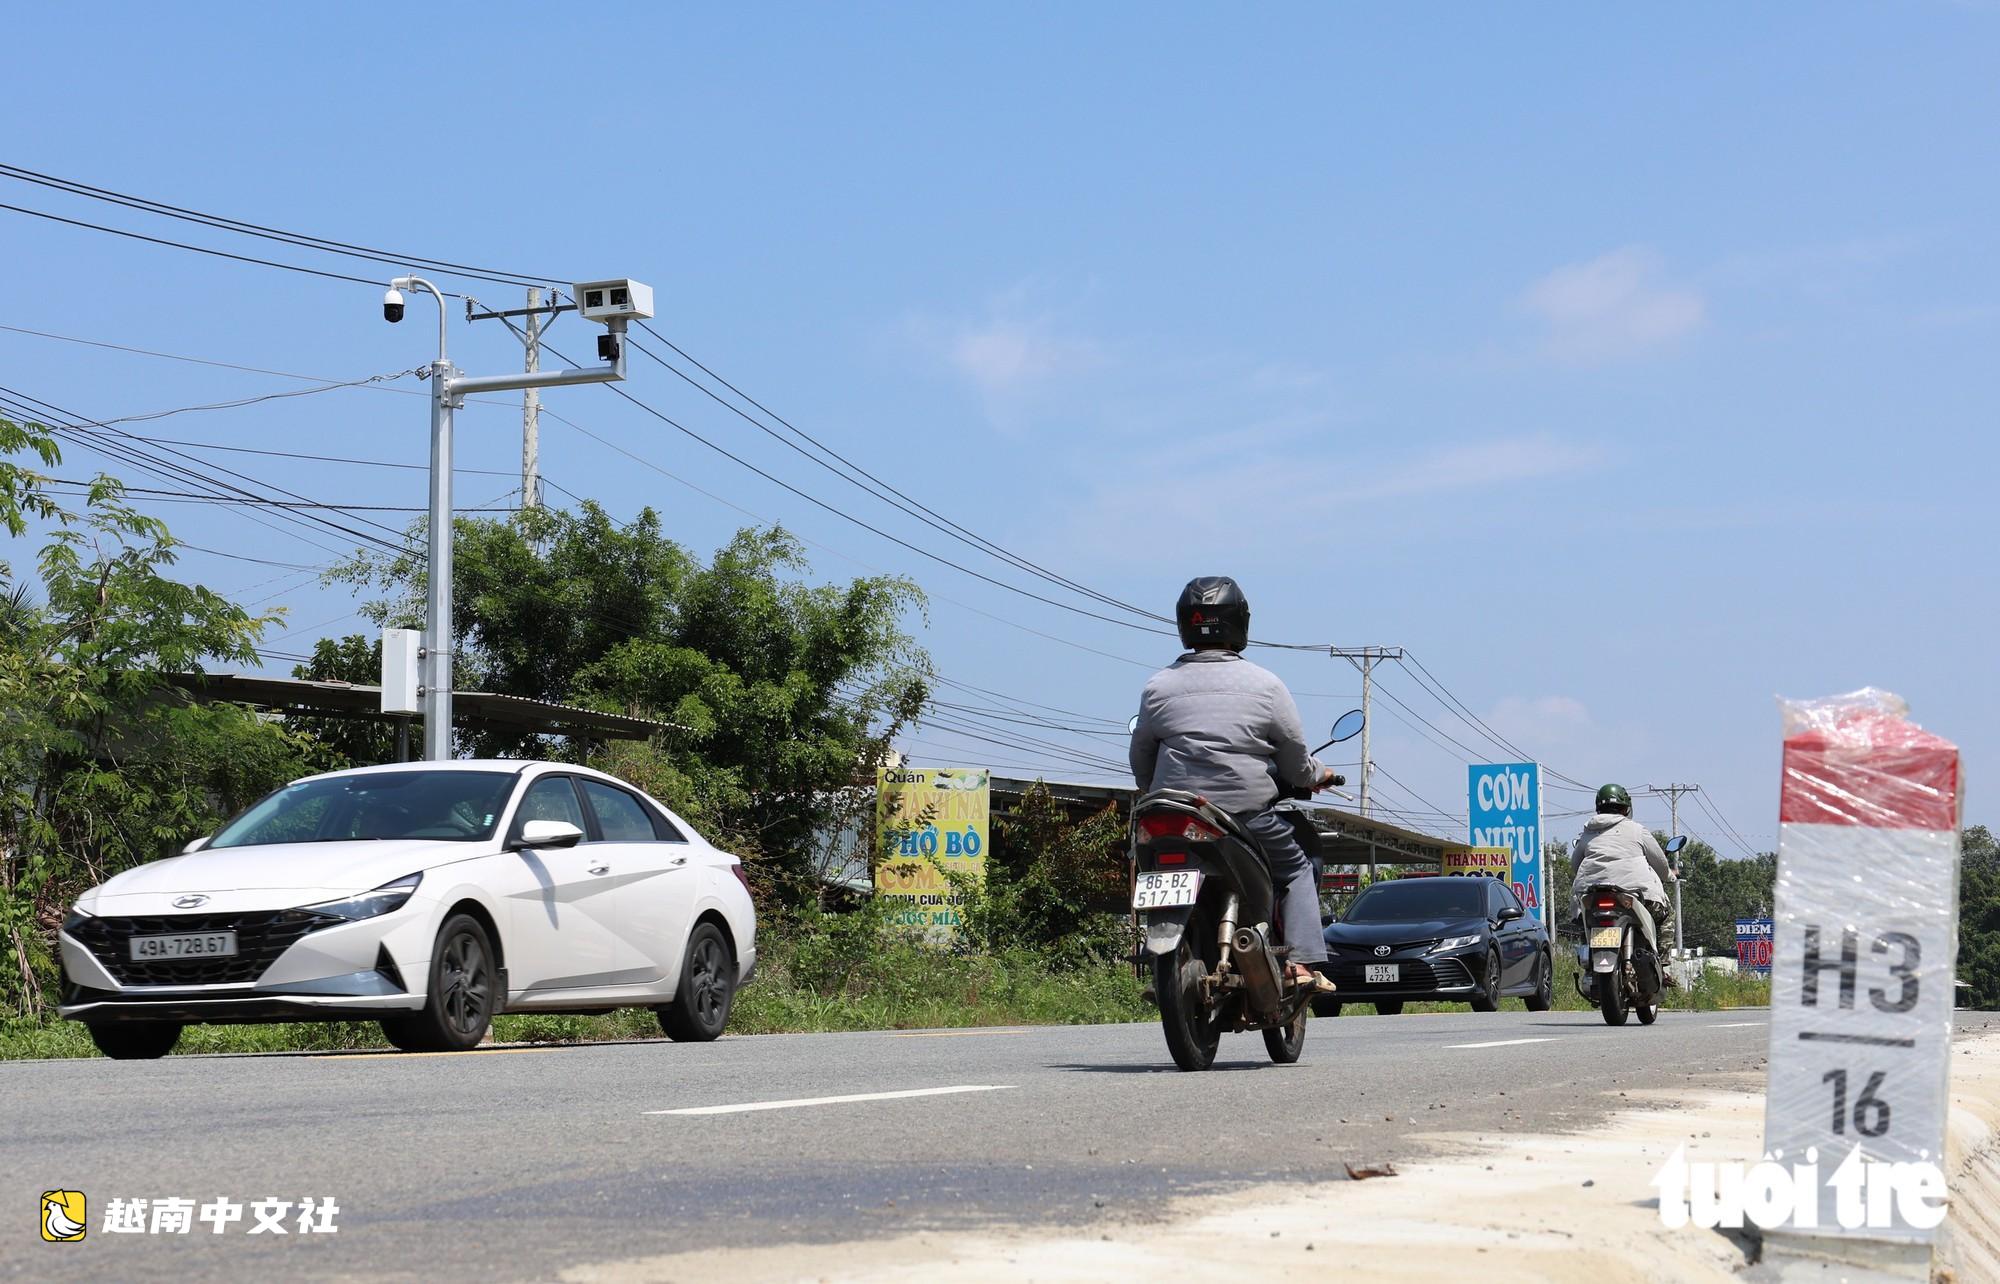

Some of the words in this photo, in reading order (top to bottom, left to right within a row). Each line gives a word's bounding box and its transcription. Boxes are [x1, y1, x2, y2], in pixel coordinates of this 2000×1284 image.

[885, 769, 925, 784] Quán
[1478, 766, 1530, 811] CƠM
[957, 791, 984, 820] NA
[945, 825, 982, 857] BÒ
[1445, 850, 1487, 867] THÀNH
[1490, 854, 1508, 867] NA
[1137, 889, 1192, 907] 517.11
[932, 908, 961, 926] MÍA
[1736, 919, 1771, 935] ĐIỂM
[139, 936, 226, 956] 49A-728.67
[1374, 966, 1389, 974] 51K
[1800, 925, 1922, 1014] H3
[1822, 1069, 1891, 1138] 16
